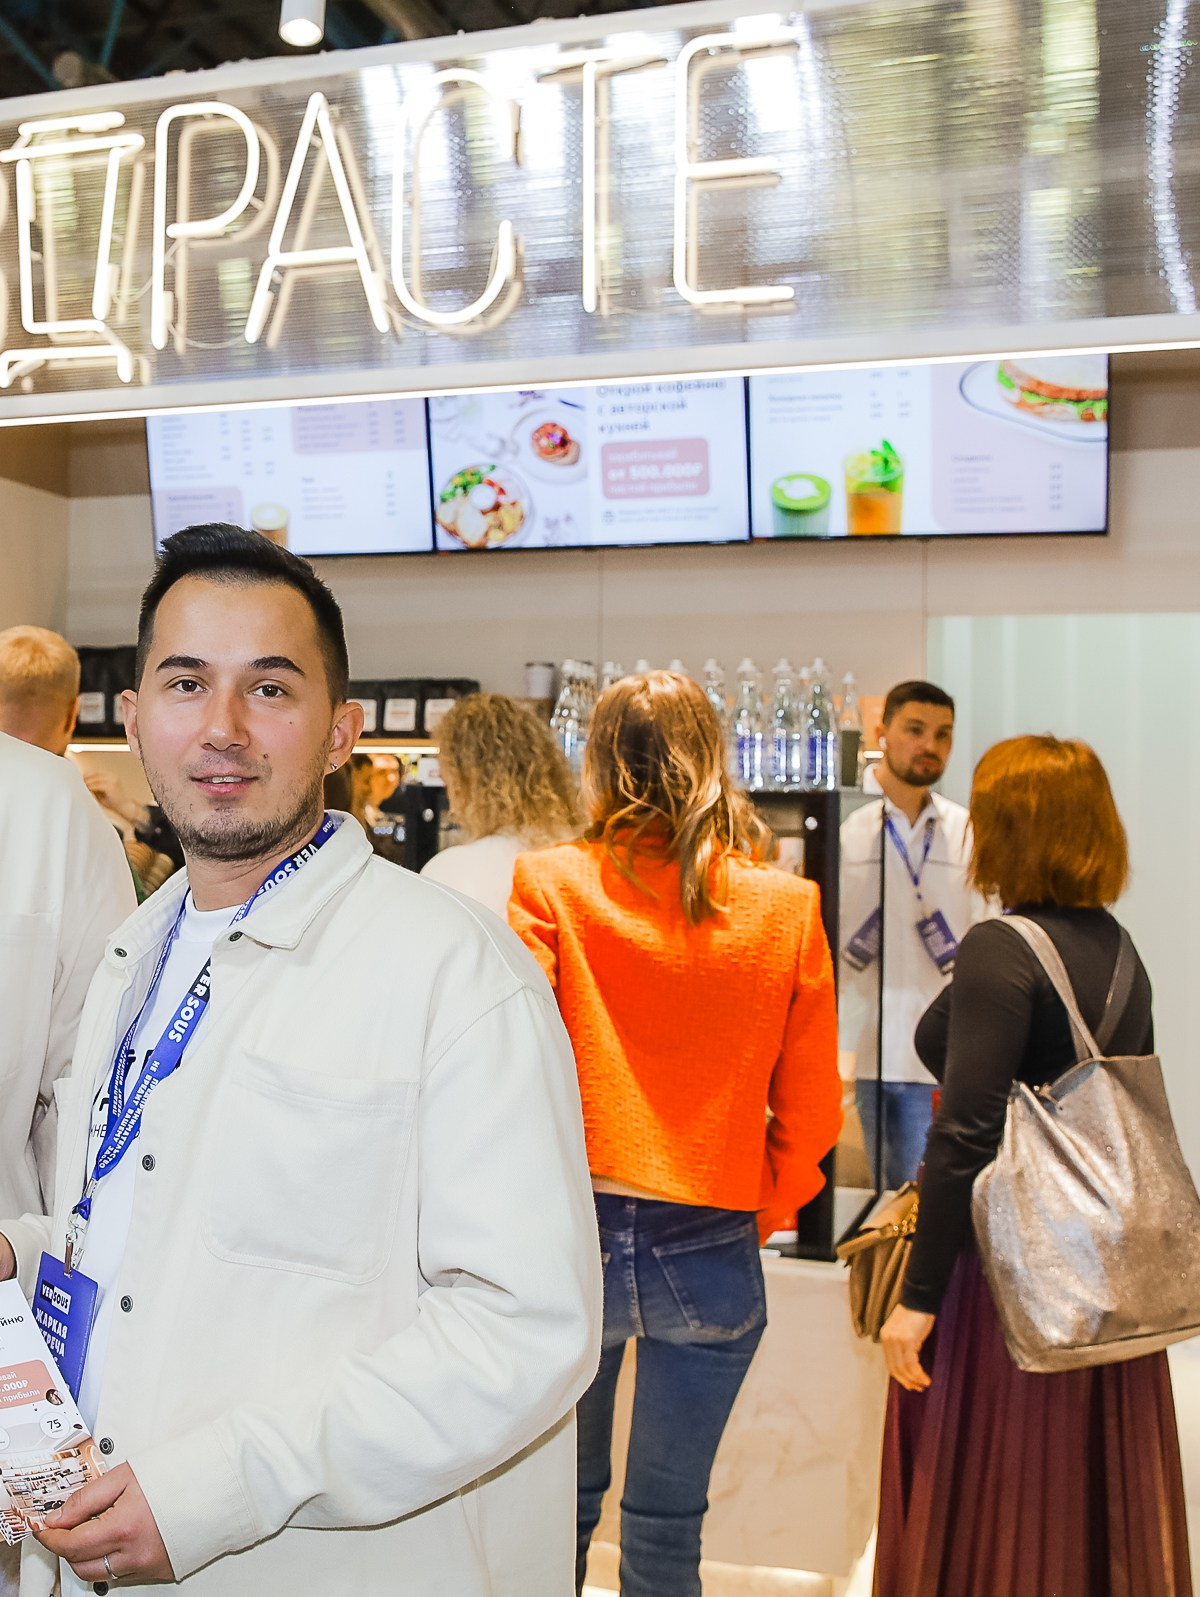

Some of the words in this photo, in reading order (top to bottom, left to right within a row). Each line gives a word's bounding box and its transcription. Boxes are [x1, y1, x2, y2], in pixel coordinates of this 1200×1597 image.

[36, 1308, 68, 1339] ЖАРКАЯ
[4, 1389, 40, 1403] прибыли
[46, 1419, 62, 1429] 75
